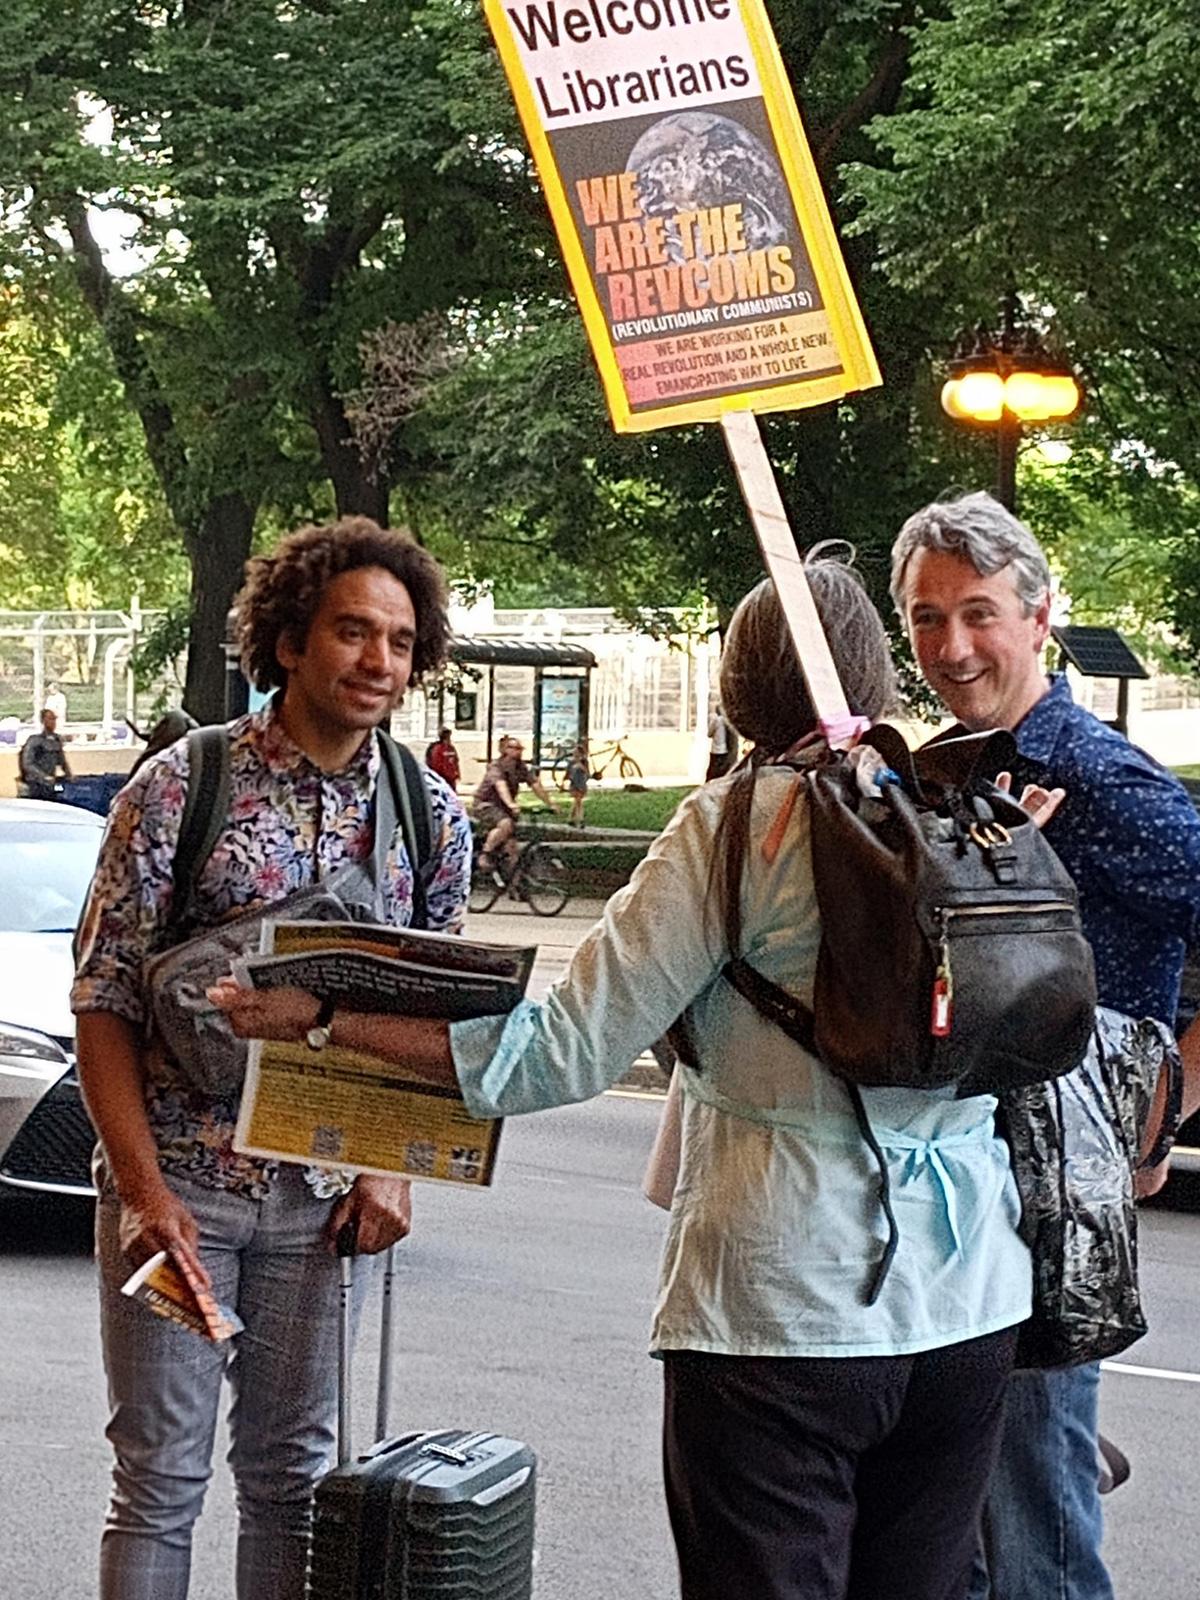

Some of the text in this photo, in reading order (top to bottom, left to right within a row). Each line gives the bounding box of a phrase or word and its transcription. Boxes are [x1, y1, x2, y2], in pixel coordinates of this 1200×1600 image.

[507, 0, 730, 51] Welcome
[535, 55, 750, 118] Librarians
[576, 172, 642, 226] WE
[595, 203, 746, 274] ARE THE
[608, 245, 796, 321] REVCOMS
[612, 291, 813, 341] (REVOLUTIONARY COMMUNISTS)
[654, 321, 788, 357] WE ARE WORKING FOR A
[622, 365, 652, 382] REAL
[653, 353, 723, 376] REVOLUTION
[726, 348, 748, 365] AND
[750, 345, 758, 359] A
[761, 339, 800, 356] WHOLE
[655, 356, 808, 395] EMANCIPATING WAY TO LIVE
